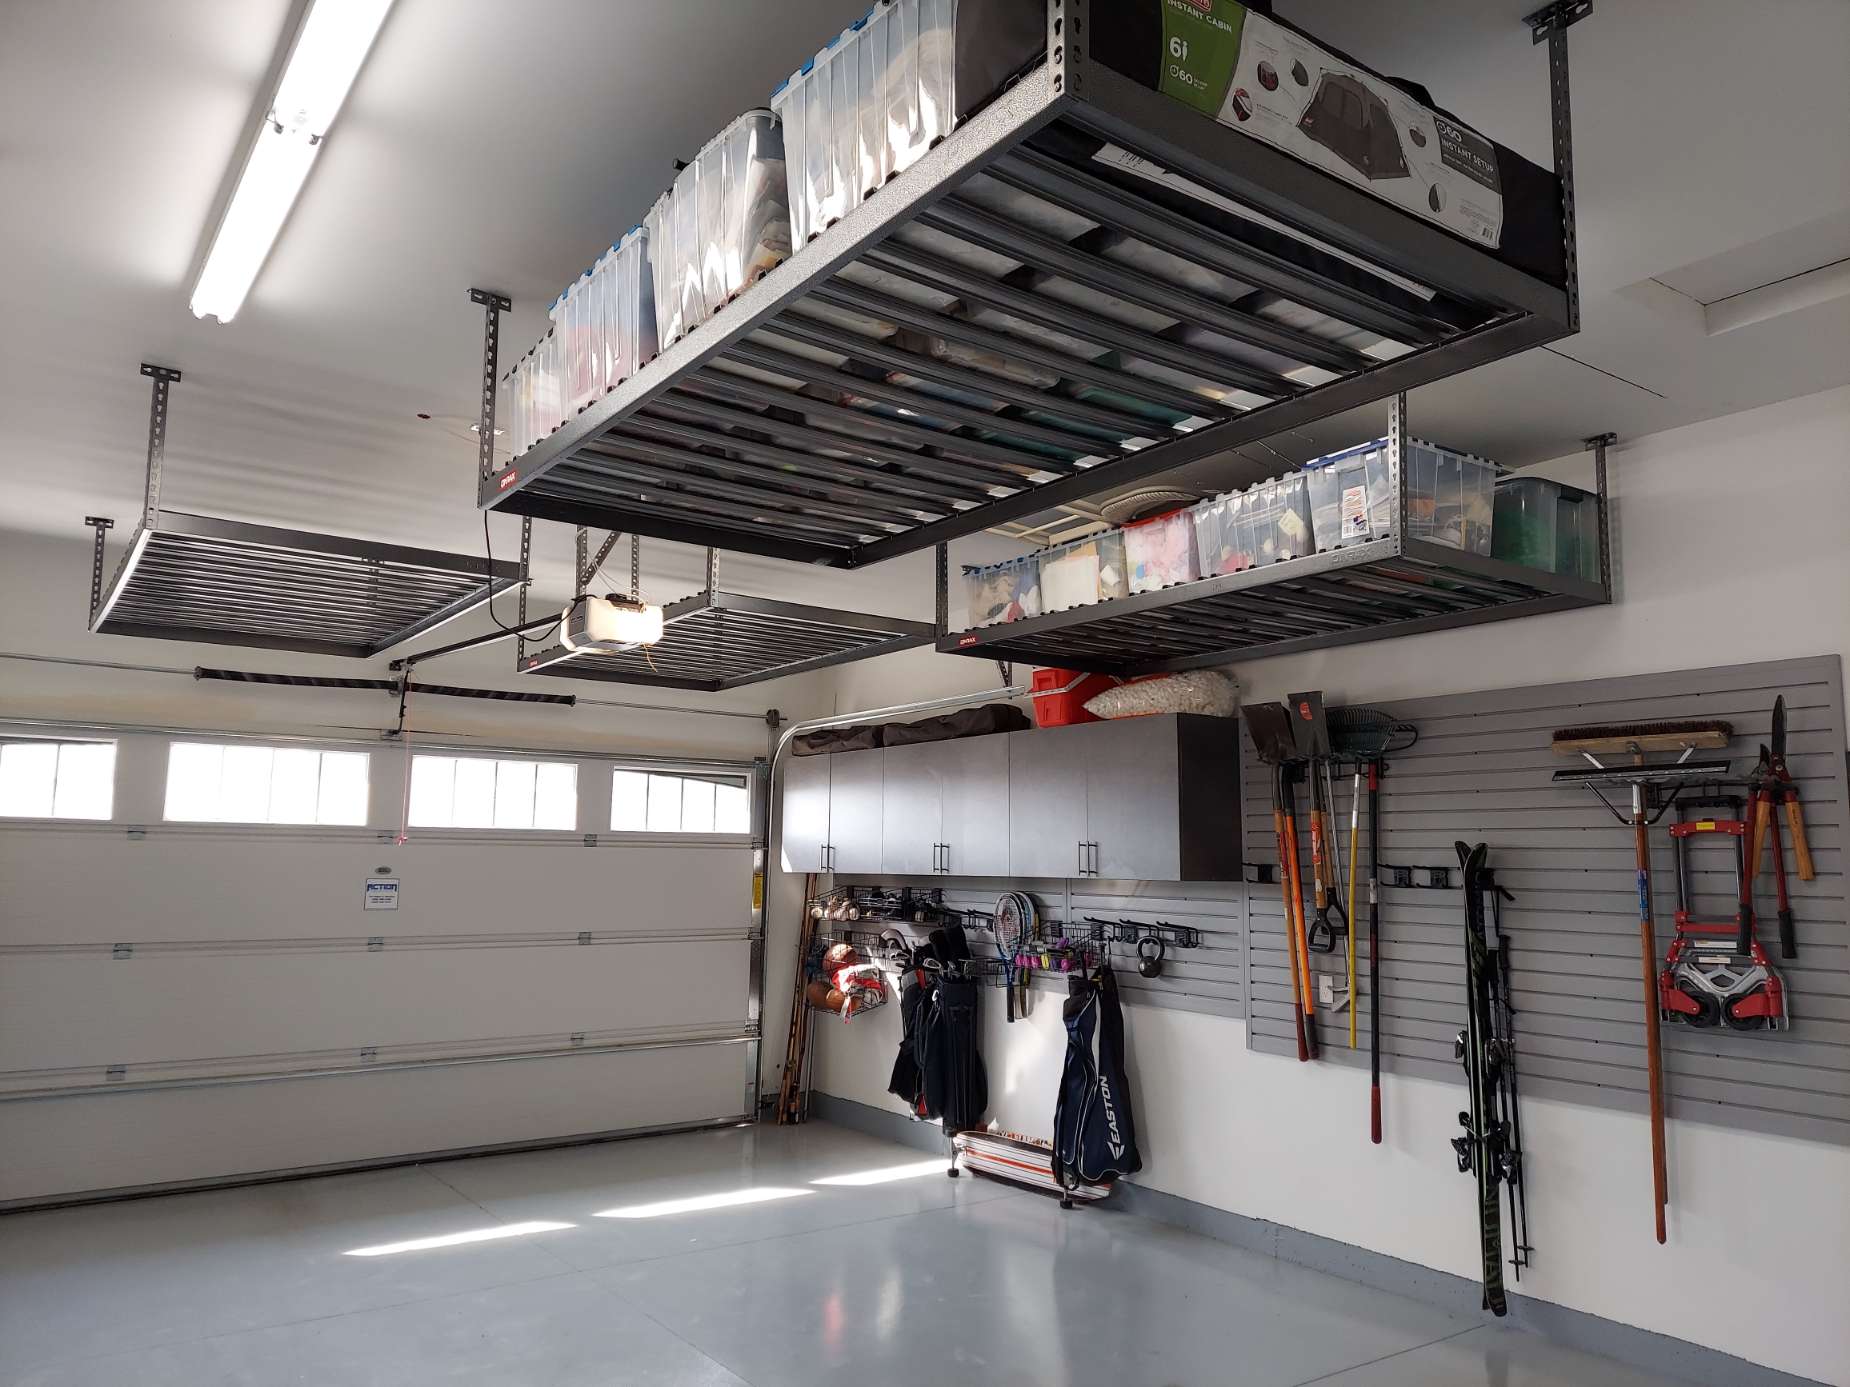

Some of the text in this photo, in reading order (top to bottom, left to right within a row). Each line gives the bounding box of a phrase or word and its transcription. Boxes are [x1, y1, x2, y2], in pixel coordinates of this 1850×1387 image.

[1206, 15, 1232, 33] CABIN
[1179, 70, 1193, 84] 60
[1441, 138, 1471, 160] INSTANT
[1473, 154, 1494, 172] SETUP
[1100, 1075, 1120, 1144] EASTON
